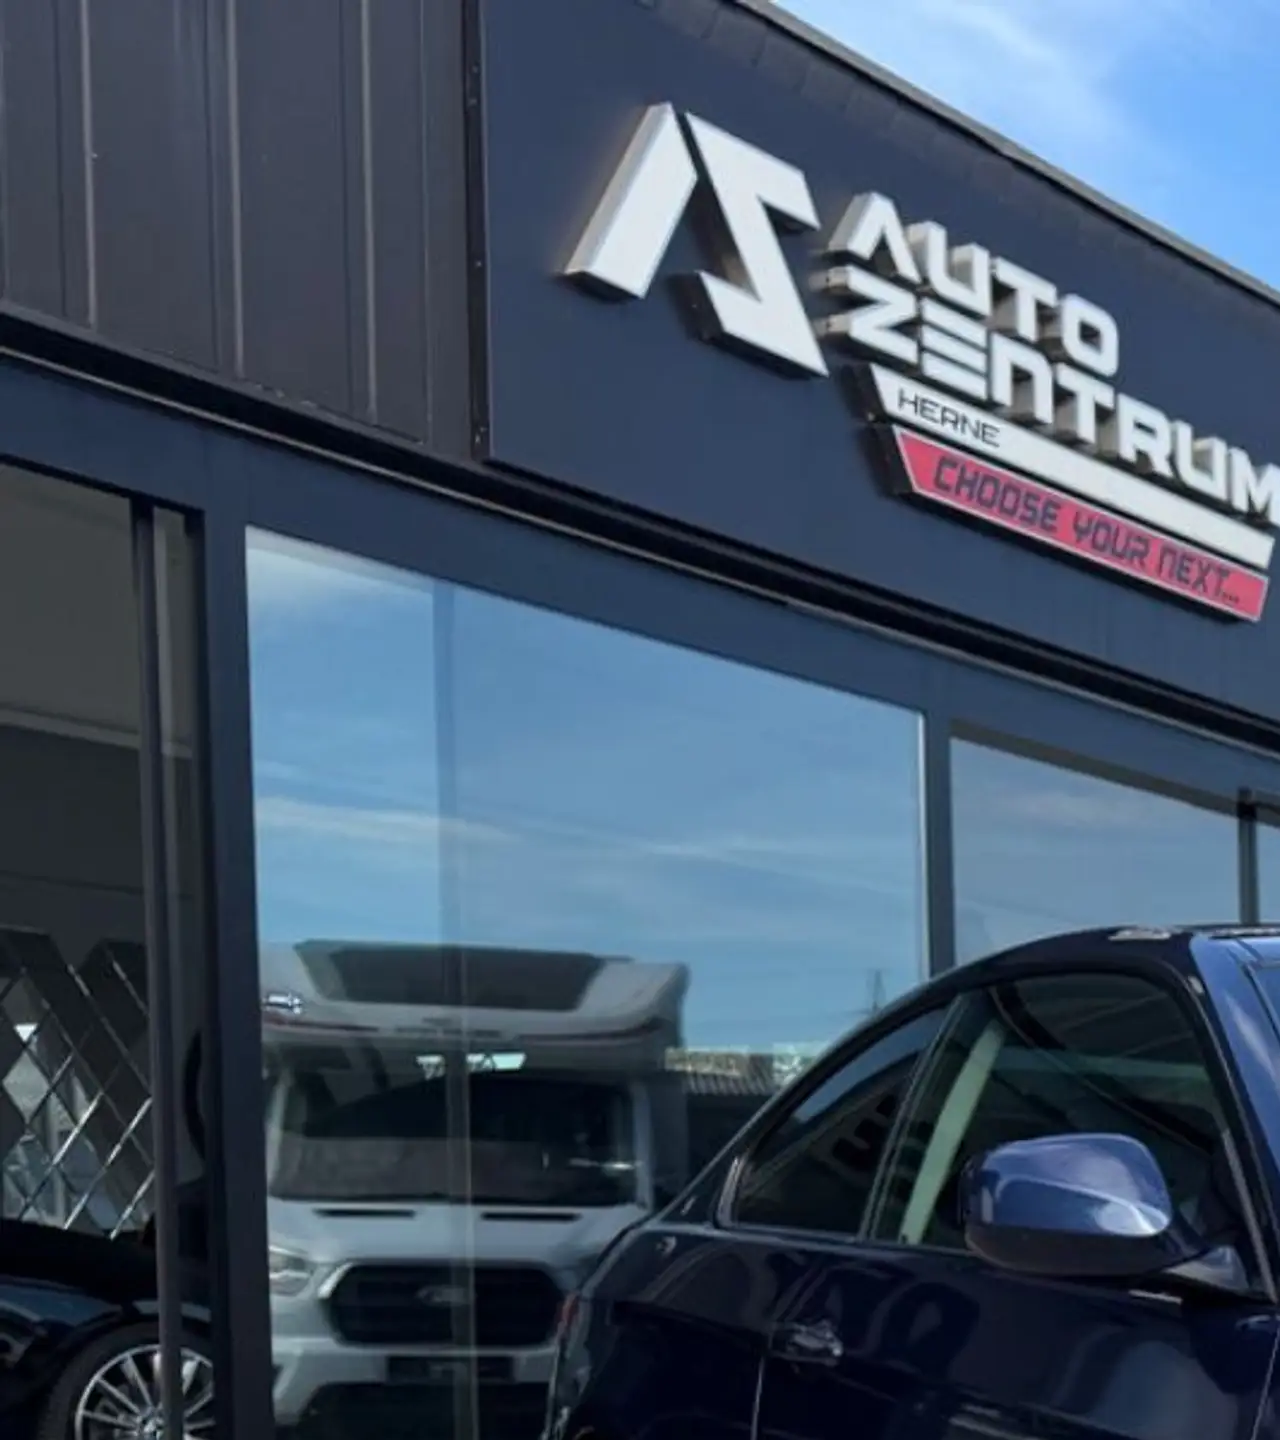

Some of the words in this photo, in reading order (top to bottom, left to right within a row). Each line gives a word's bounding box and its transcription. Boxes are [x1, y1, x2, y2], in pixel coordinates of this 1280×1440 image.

[830, 191, 1120, 377] AUTO
[898, 387, 1001, 448] HERNE
[933, 455, 1062, 532] CHOOSE
[1073, 510, 1149, 573] YOUR
